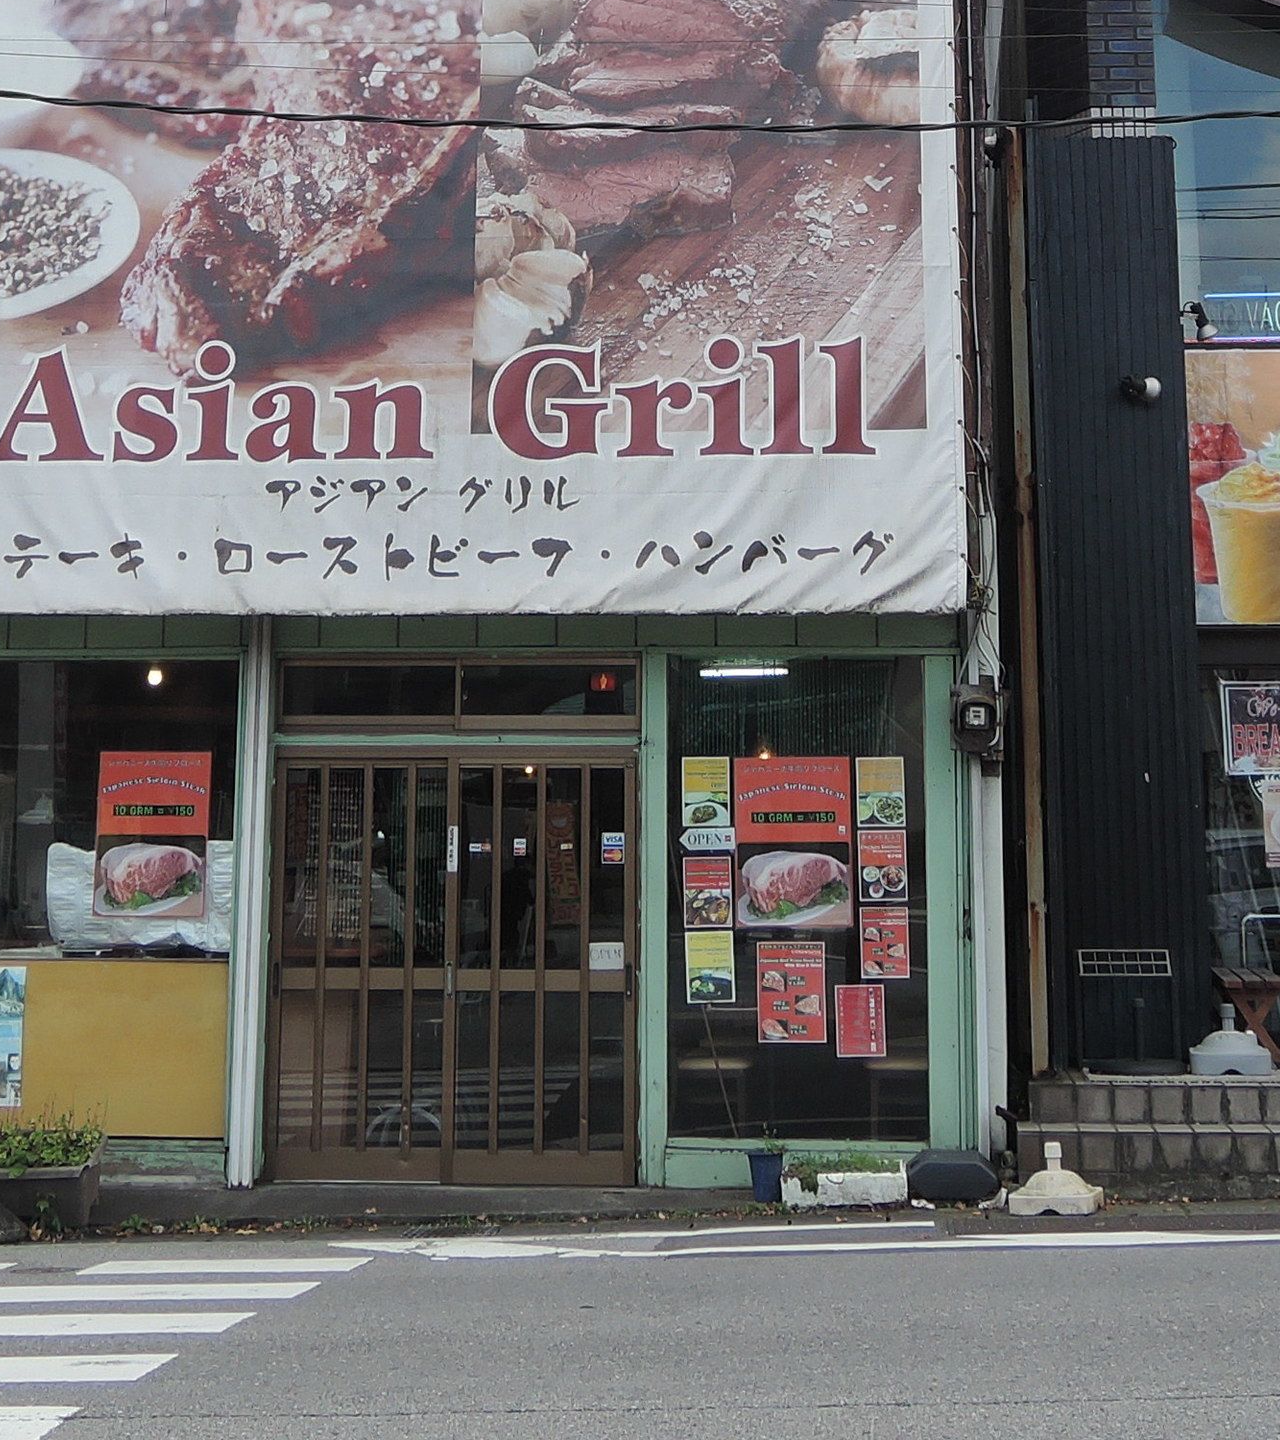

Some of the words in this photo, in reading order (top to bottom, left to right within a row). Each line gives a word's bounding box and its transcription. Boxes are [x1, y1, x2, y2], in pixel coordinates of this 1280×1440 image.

[488, 334, 880, 461] Grill
[265, 475, 428, 513] アジアン
[459, 475, 581, 514] グリル
[115, 806, 127, 815] 10
[753, 813, 765, 822] 10
[688, 833, 722, 846] OPEN
